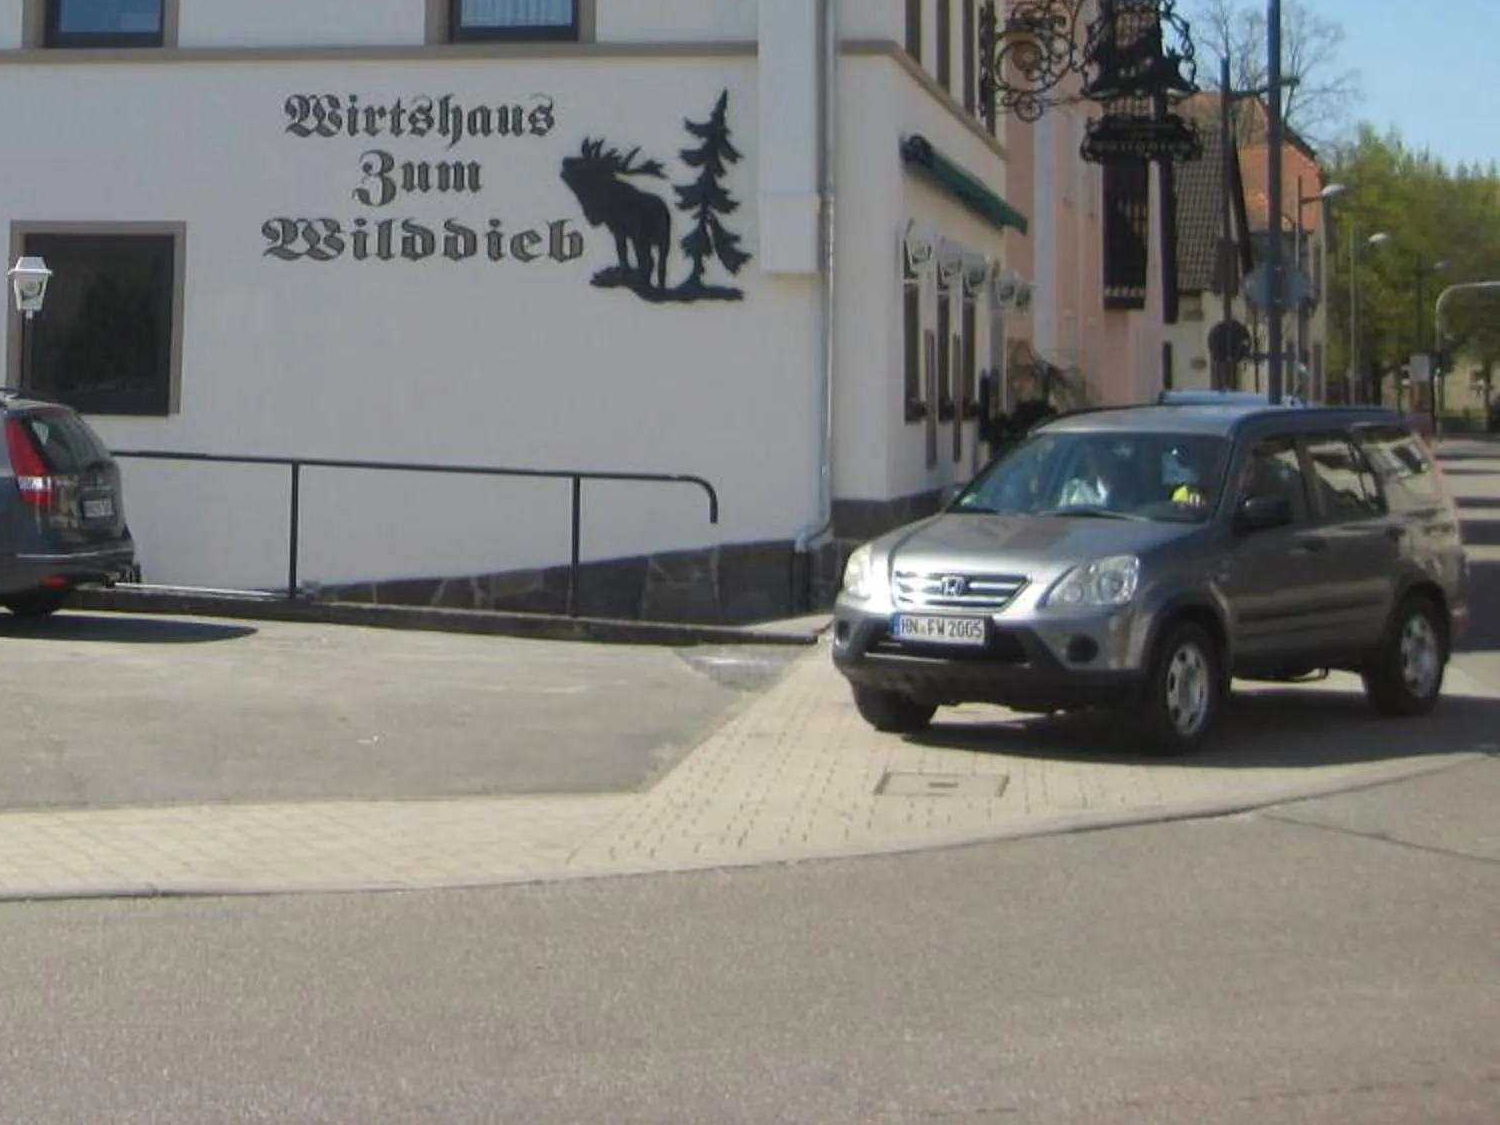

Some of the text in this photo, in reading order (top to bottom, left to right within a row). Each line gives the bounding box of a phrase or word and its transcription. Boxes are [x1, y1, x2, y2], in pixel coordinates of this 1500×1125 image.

[284, 93, 555, 148] Wirtshaus
[352, 149, 482, 207] Zum
[261, 216, 585, 263] Wilddieb
